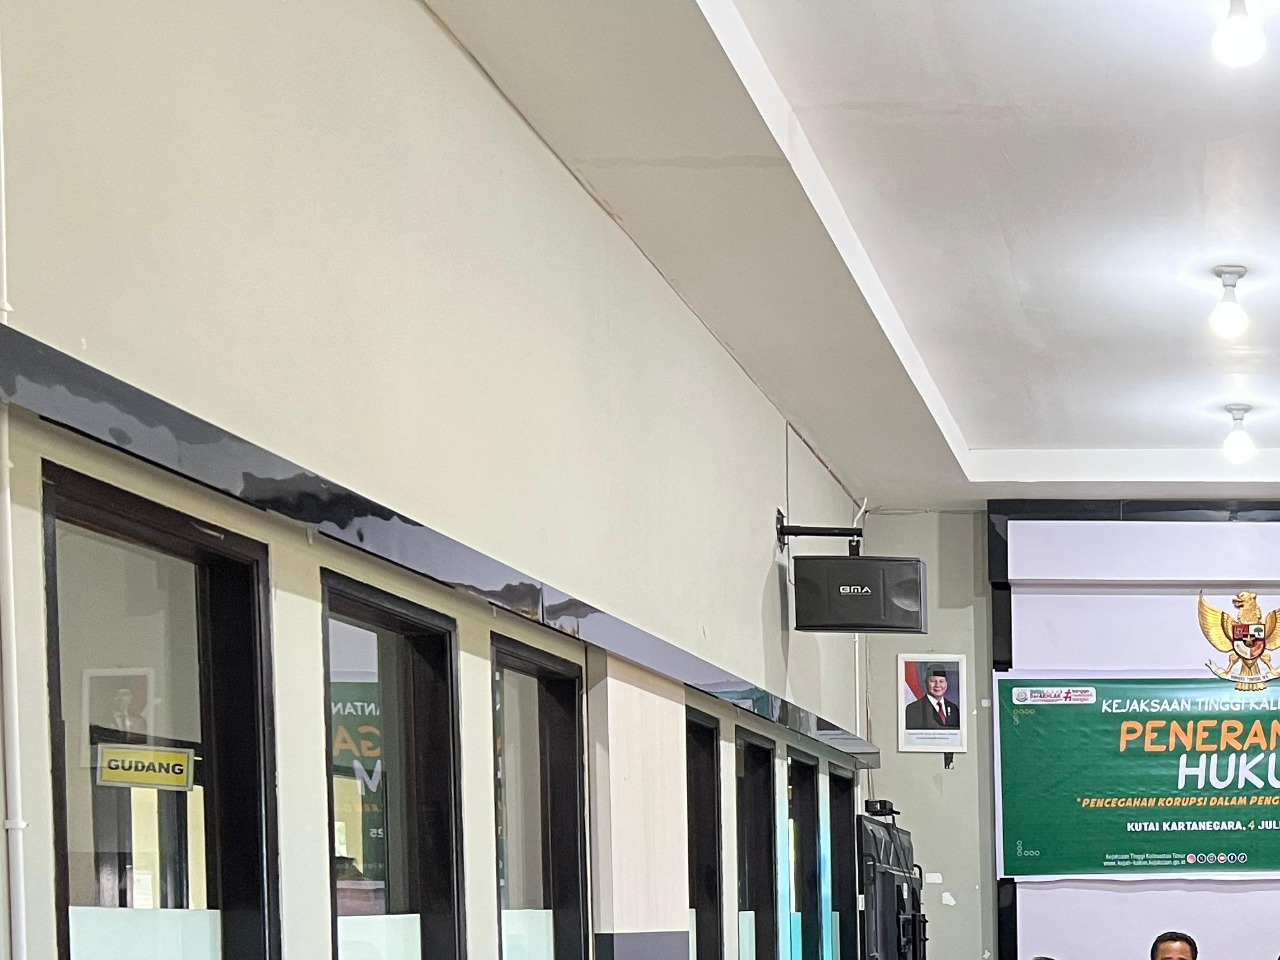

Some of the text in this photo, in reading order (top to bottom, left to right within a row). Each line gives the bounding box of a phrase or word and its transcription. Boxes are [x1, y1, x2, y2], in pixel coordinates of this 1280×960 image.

[1101, 699, 1191, 713] KEJAKSAAN
[1197, 697, 1245, 711] TINGGI
[107, 758, 184, 775] GUDANG
[1157, 796, 1208, 807] KORUPSI
[1209, 796, 1248, 806] DALAM
[1126, 822, 1160, 832] KUTAI
[1247, 820, 1256, 831] 4
